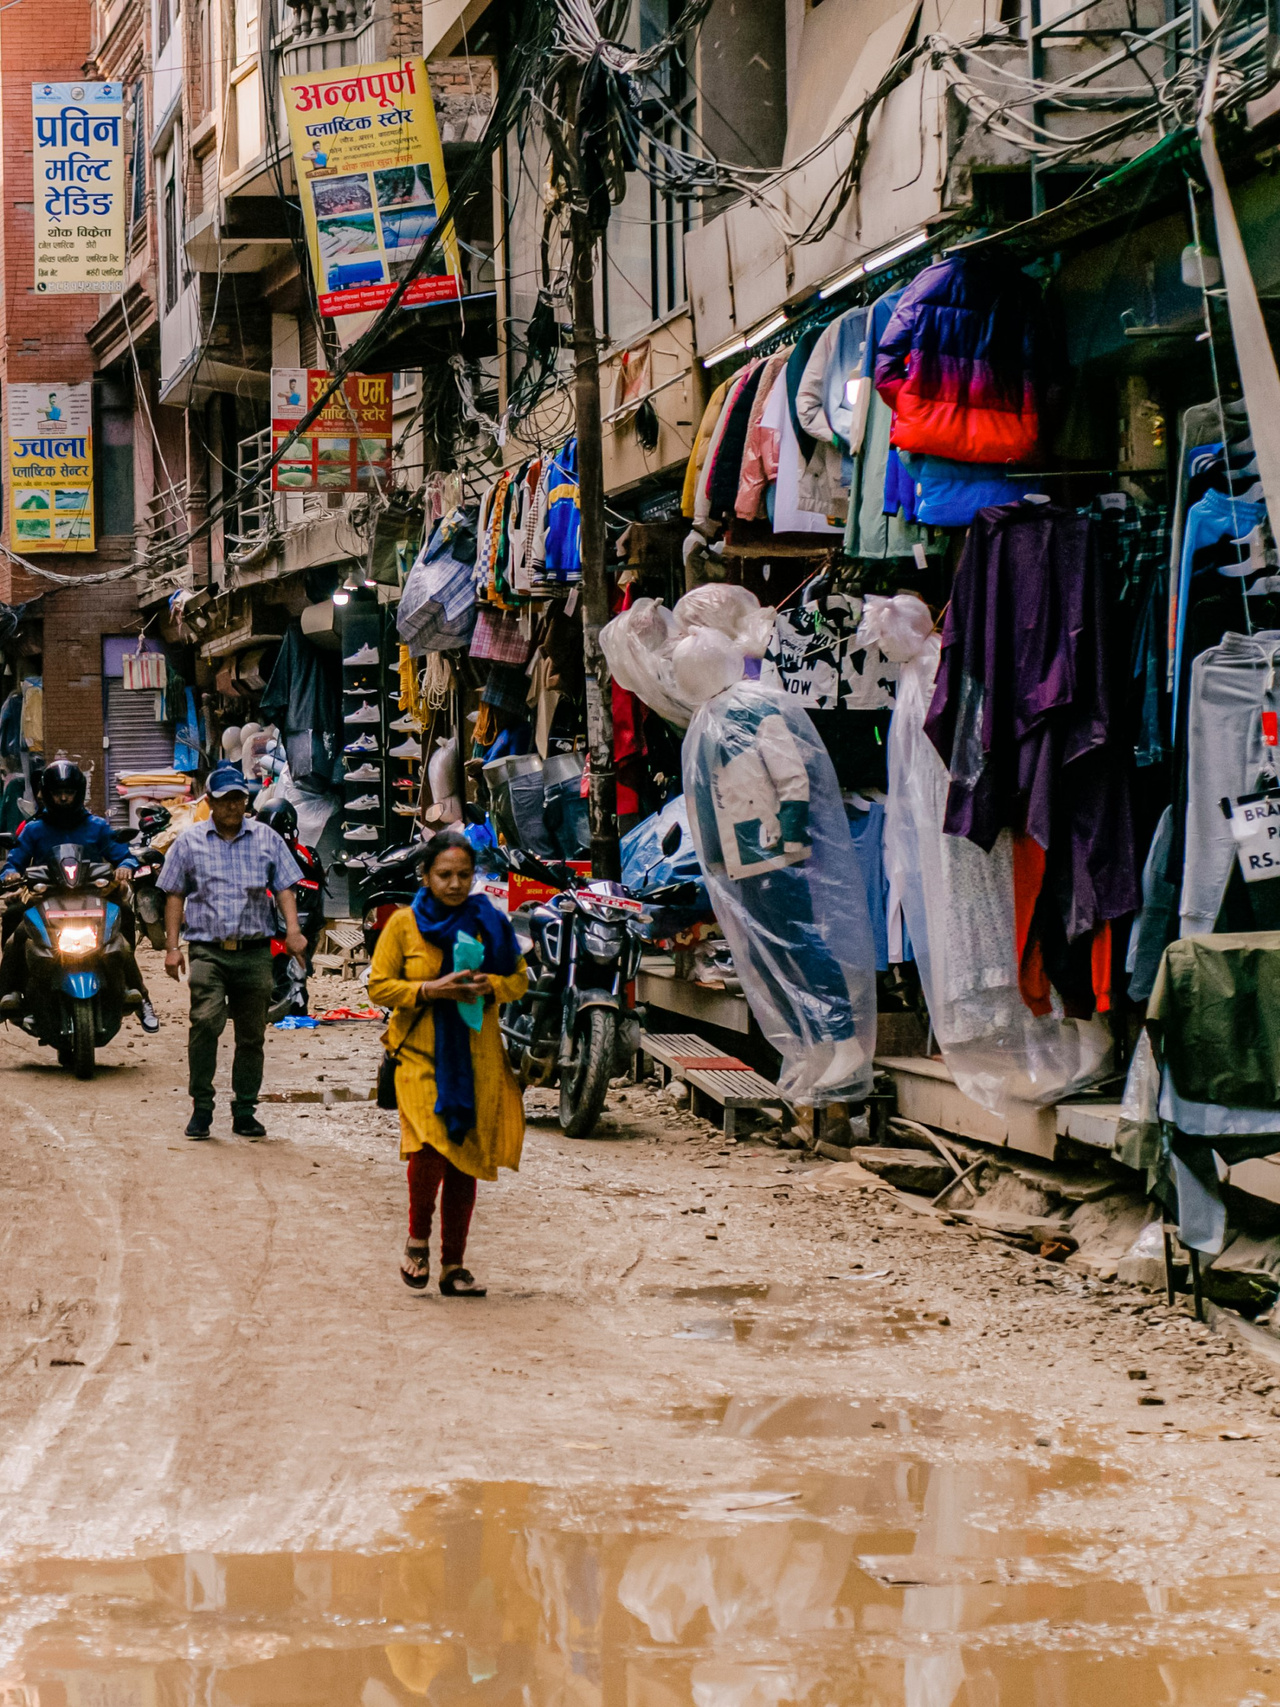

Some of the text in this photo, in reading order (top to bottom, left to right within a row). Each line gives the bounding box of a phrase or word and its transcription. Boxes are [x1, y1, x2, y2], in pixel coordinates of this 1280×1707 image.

[291, 61, 417, 112] अन्नपूर्ण
[35, 106, 121, 148] प्रविन
[305, 108, 414, 138] प्लाष्टिक स्टोर
[45, 151, 112, 182] मल्टि
[45, 186, 113, 223] ट्रेडिङ
[47, 226, 112, 238] थोक विक्रेता
[358, 378, 390, 406] एम.
[361, 406, 387, 421] स्टोर
[13, 438, 87, 460] ज्वाला
[12, 463, 90, 478] प्लाष्टिक सेन्टर
[1267, 826, 1280, 839] P
[1249, 852, 1280, 869] RS.
